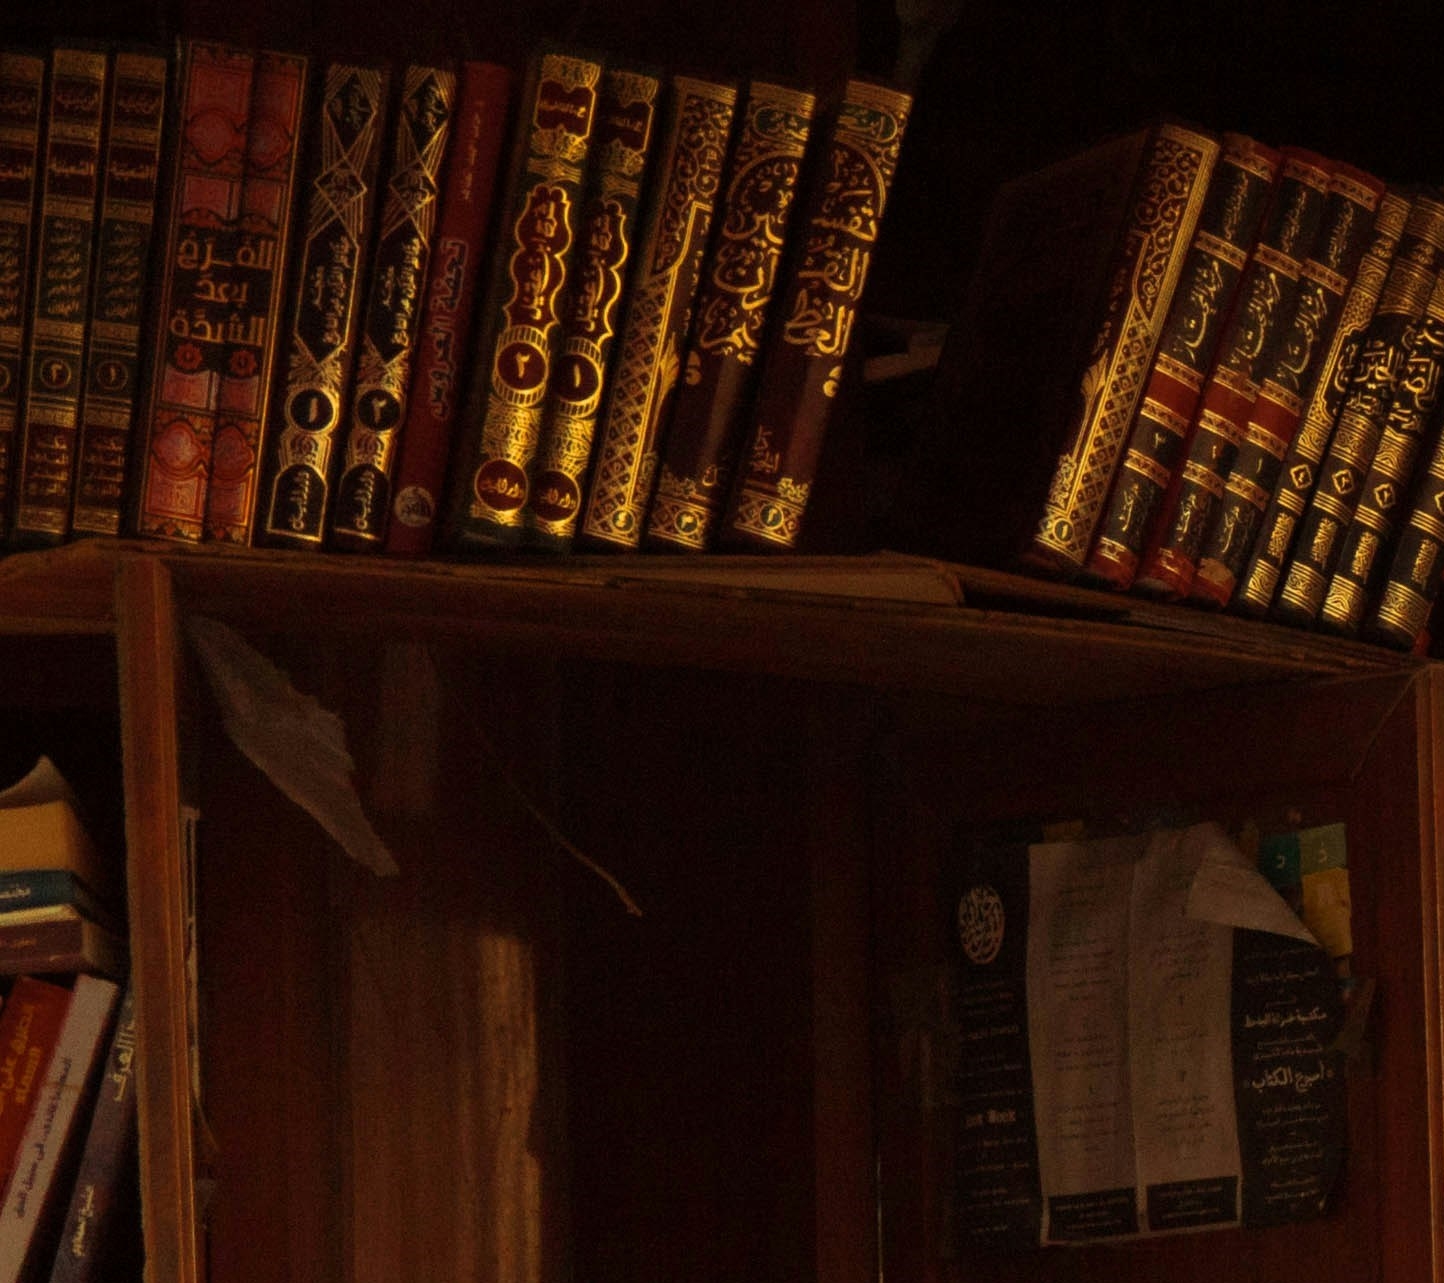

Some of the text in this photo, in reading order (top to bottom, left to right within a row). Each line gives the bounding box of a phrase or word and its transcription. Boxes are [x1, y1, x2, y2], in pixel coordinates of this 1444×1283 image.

[176, 233, 274, 271] الفرج
[194, 276, 249, 304] بعد
[170, 308, 265, 346] الشدة
